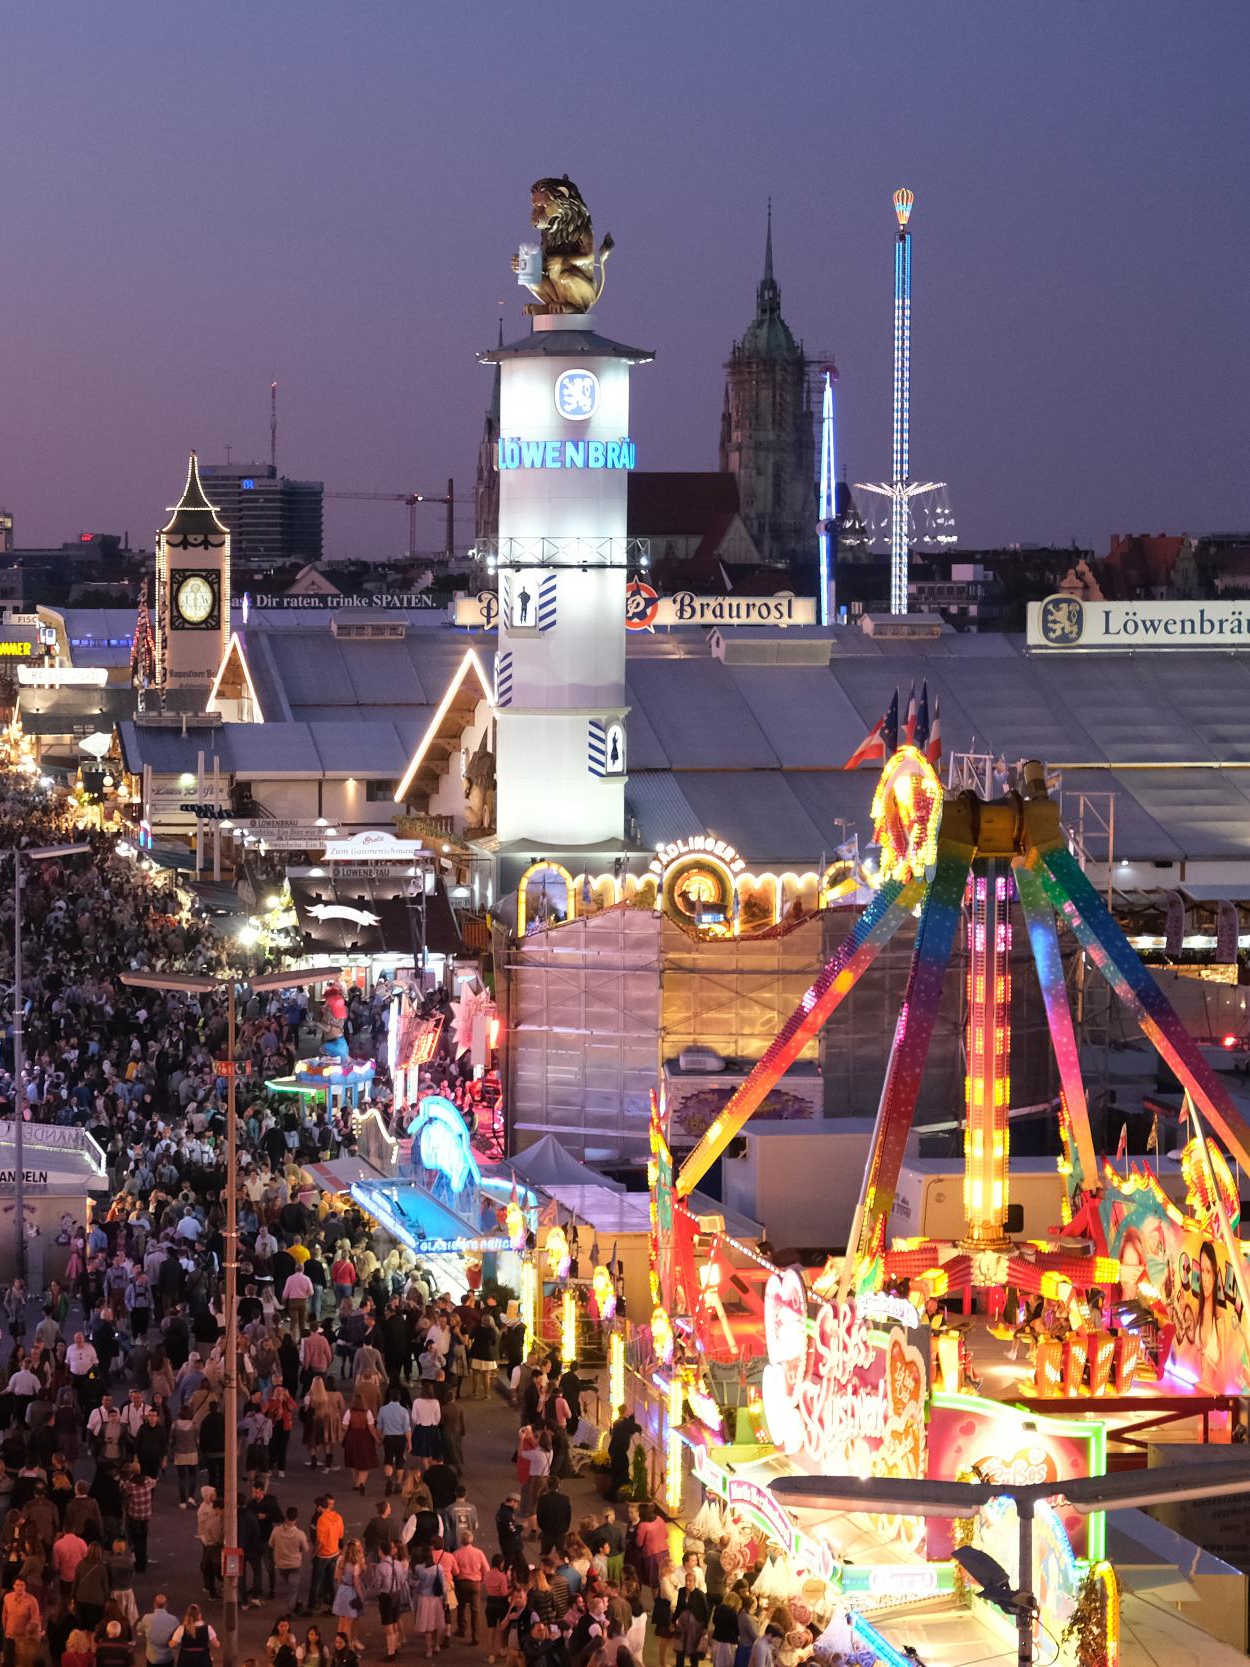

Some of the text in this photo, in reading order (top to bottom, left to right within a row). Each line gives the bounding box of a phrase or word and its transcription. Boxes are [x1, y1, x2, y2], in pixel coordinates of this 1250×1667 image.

[498, 437, 636, 470] LÖWENBRÄU
[256, 594, 279, 607] Dir
[283, 595, 324, 609] raten,
[327, 594, 369, 607] trinke
[372, 594, 437, 608] SPATEN.
